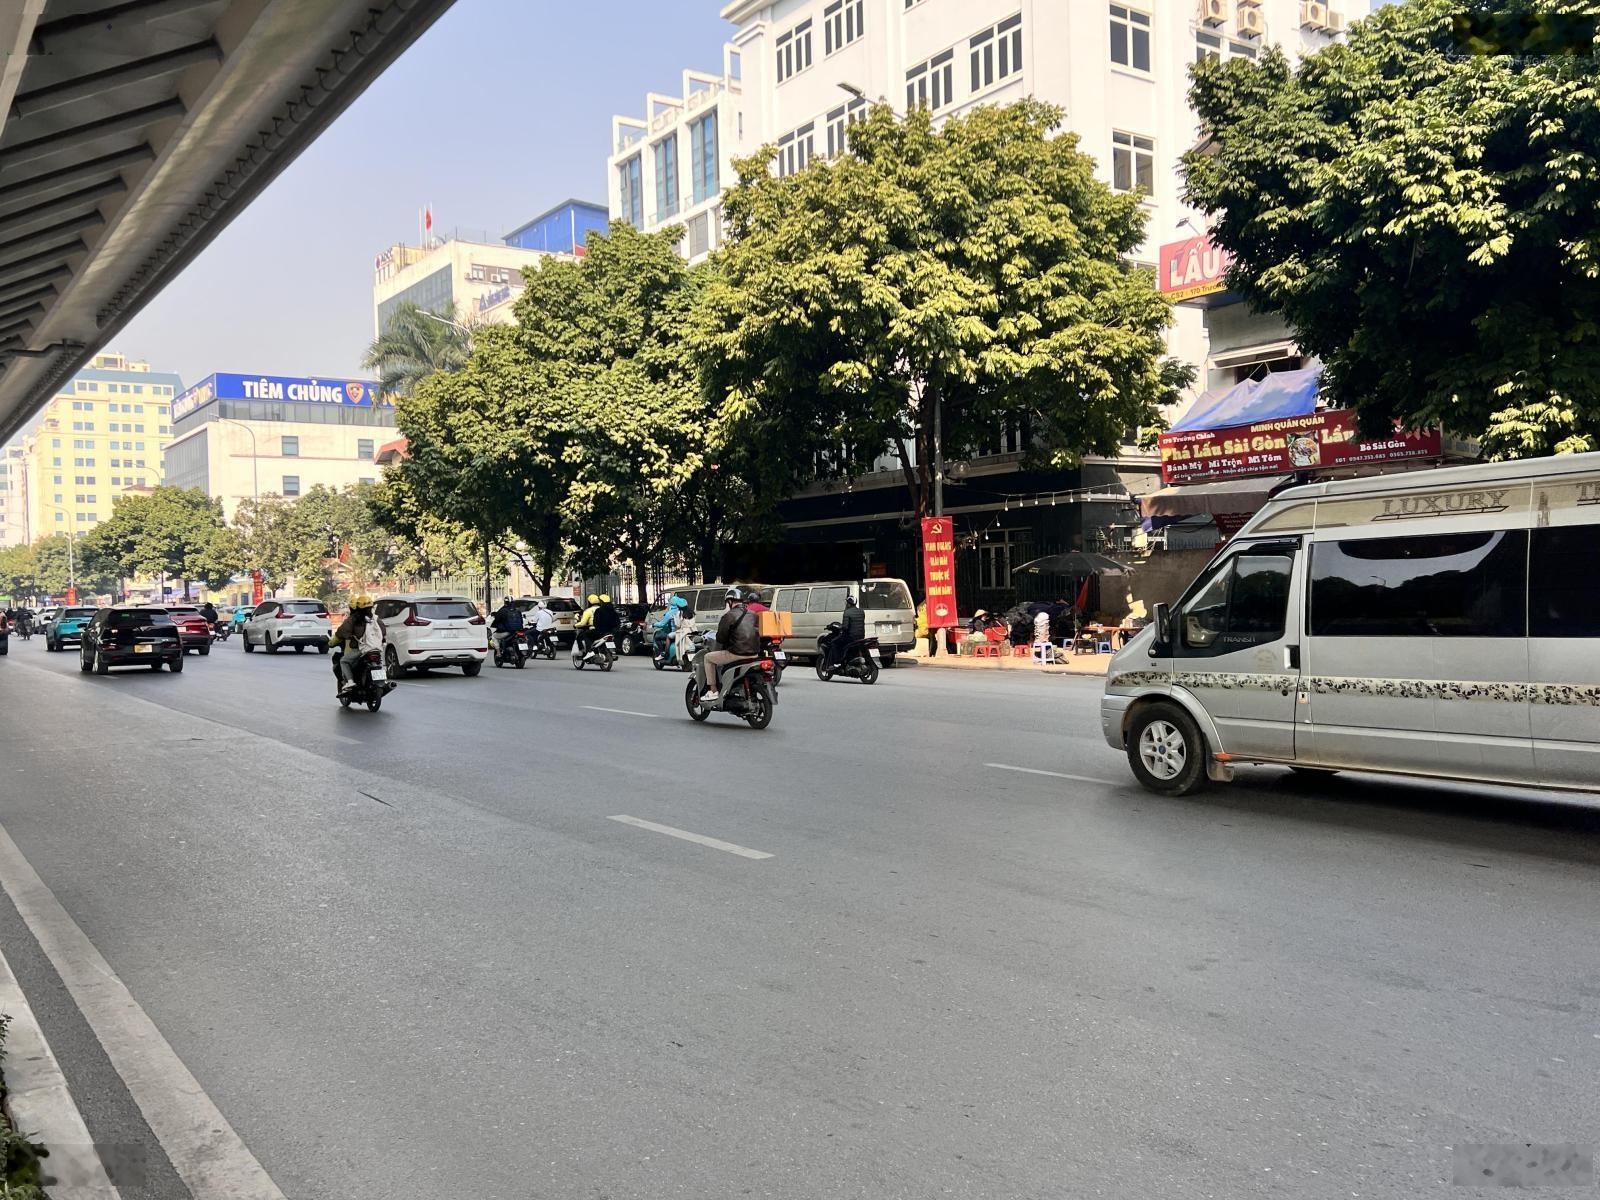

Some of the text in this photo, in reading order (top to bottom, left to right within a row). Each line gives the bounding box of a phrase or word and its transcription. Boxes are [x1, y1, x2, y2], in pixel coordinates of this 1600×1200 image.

[1170, 241, 1220, 288] LẨU
[242, 378, 284, 400] TIÊM
[287, 379, 343, 403] CHỦNG
[1250, 423, 1274, 433] MINH
[1161, 445, 1191, 461] Phá
[1223, 436, 1250, 454] Sài
[1251, 435, 1286, 451] Gòn
[1172, 435, 1195, 443] Trường
[1359, 440, 1406, 452] Bò Sài Gòn
[1166, 463, 1188, 472] Bánh
[1261, 454, 1282, 463] Tôm
[1382, 489, 1511, 515] LUXURY
